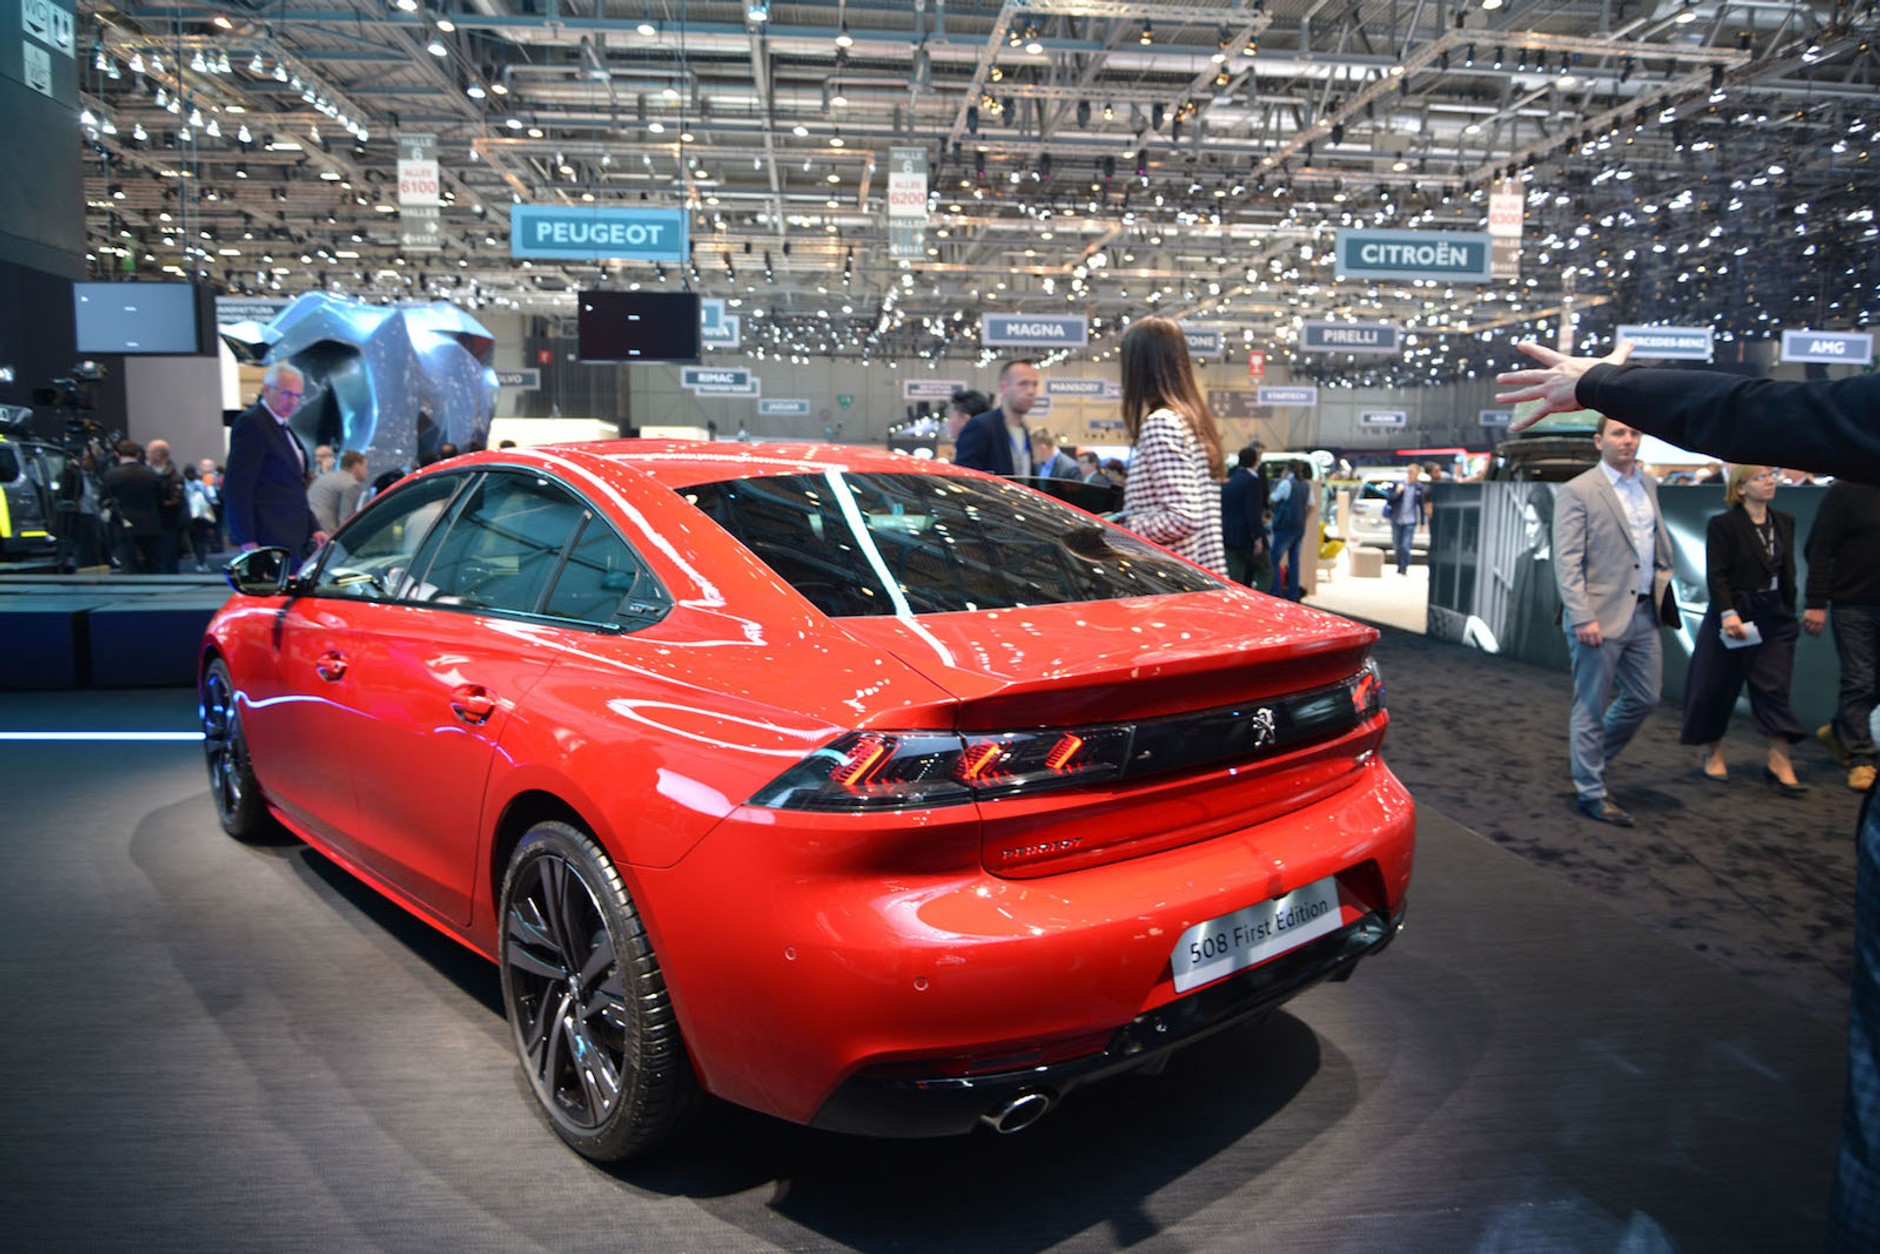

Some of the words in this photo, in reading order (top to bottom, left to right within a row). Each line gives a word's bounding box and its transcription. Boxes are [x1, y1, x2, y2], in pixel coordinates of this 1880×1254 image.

[412, 147, 423, 161] 6
[903, 160, 914, 174] 6
[401, 181, 437, 193] 6100
[891, 192, 926, 204] 6200
[536, 221, 664, 245] PEUGEOT
[1361, 241, 1467, 266] CITROËN
[1006, 323, 1065, 337] MAGNA
[1323, 329, 1378, 344] PIRELLI
[1809, 340, 1846, 355] AMG
[698, 373, 734, 384] RIMAC
[1050, 382, 1099, 392] MANSORY
[1190, 933, 1229, 964] 508
[1233, 920, 1272, 948] First
[1276, 899, 1329, 931] Edition
